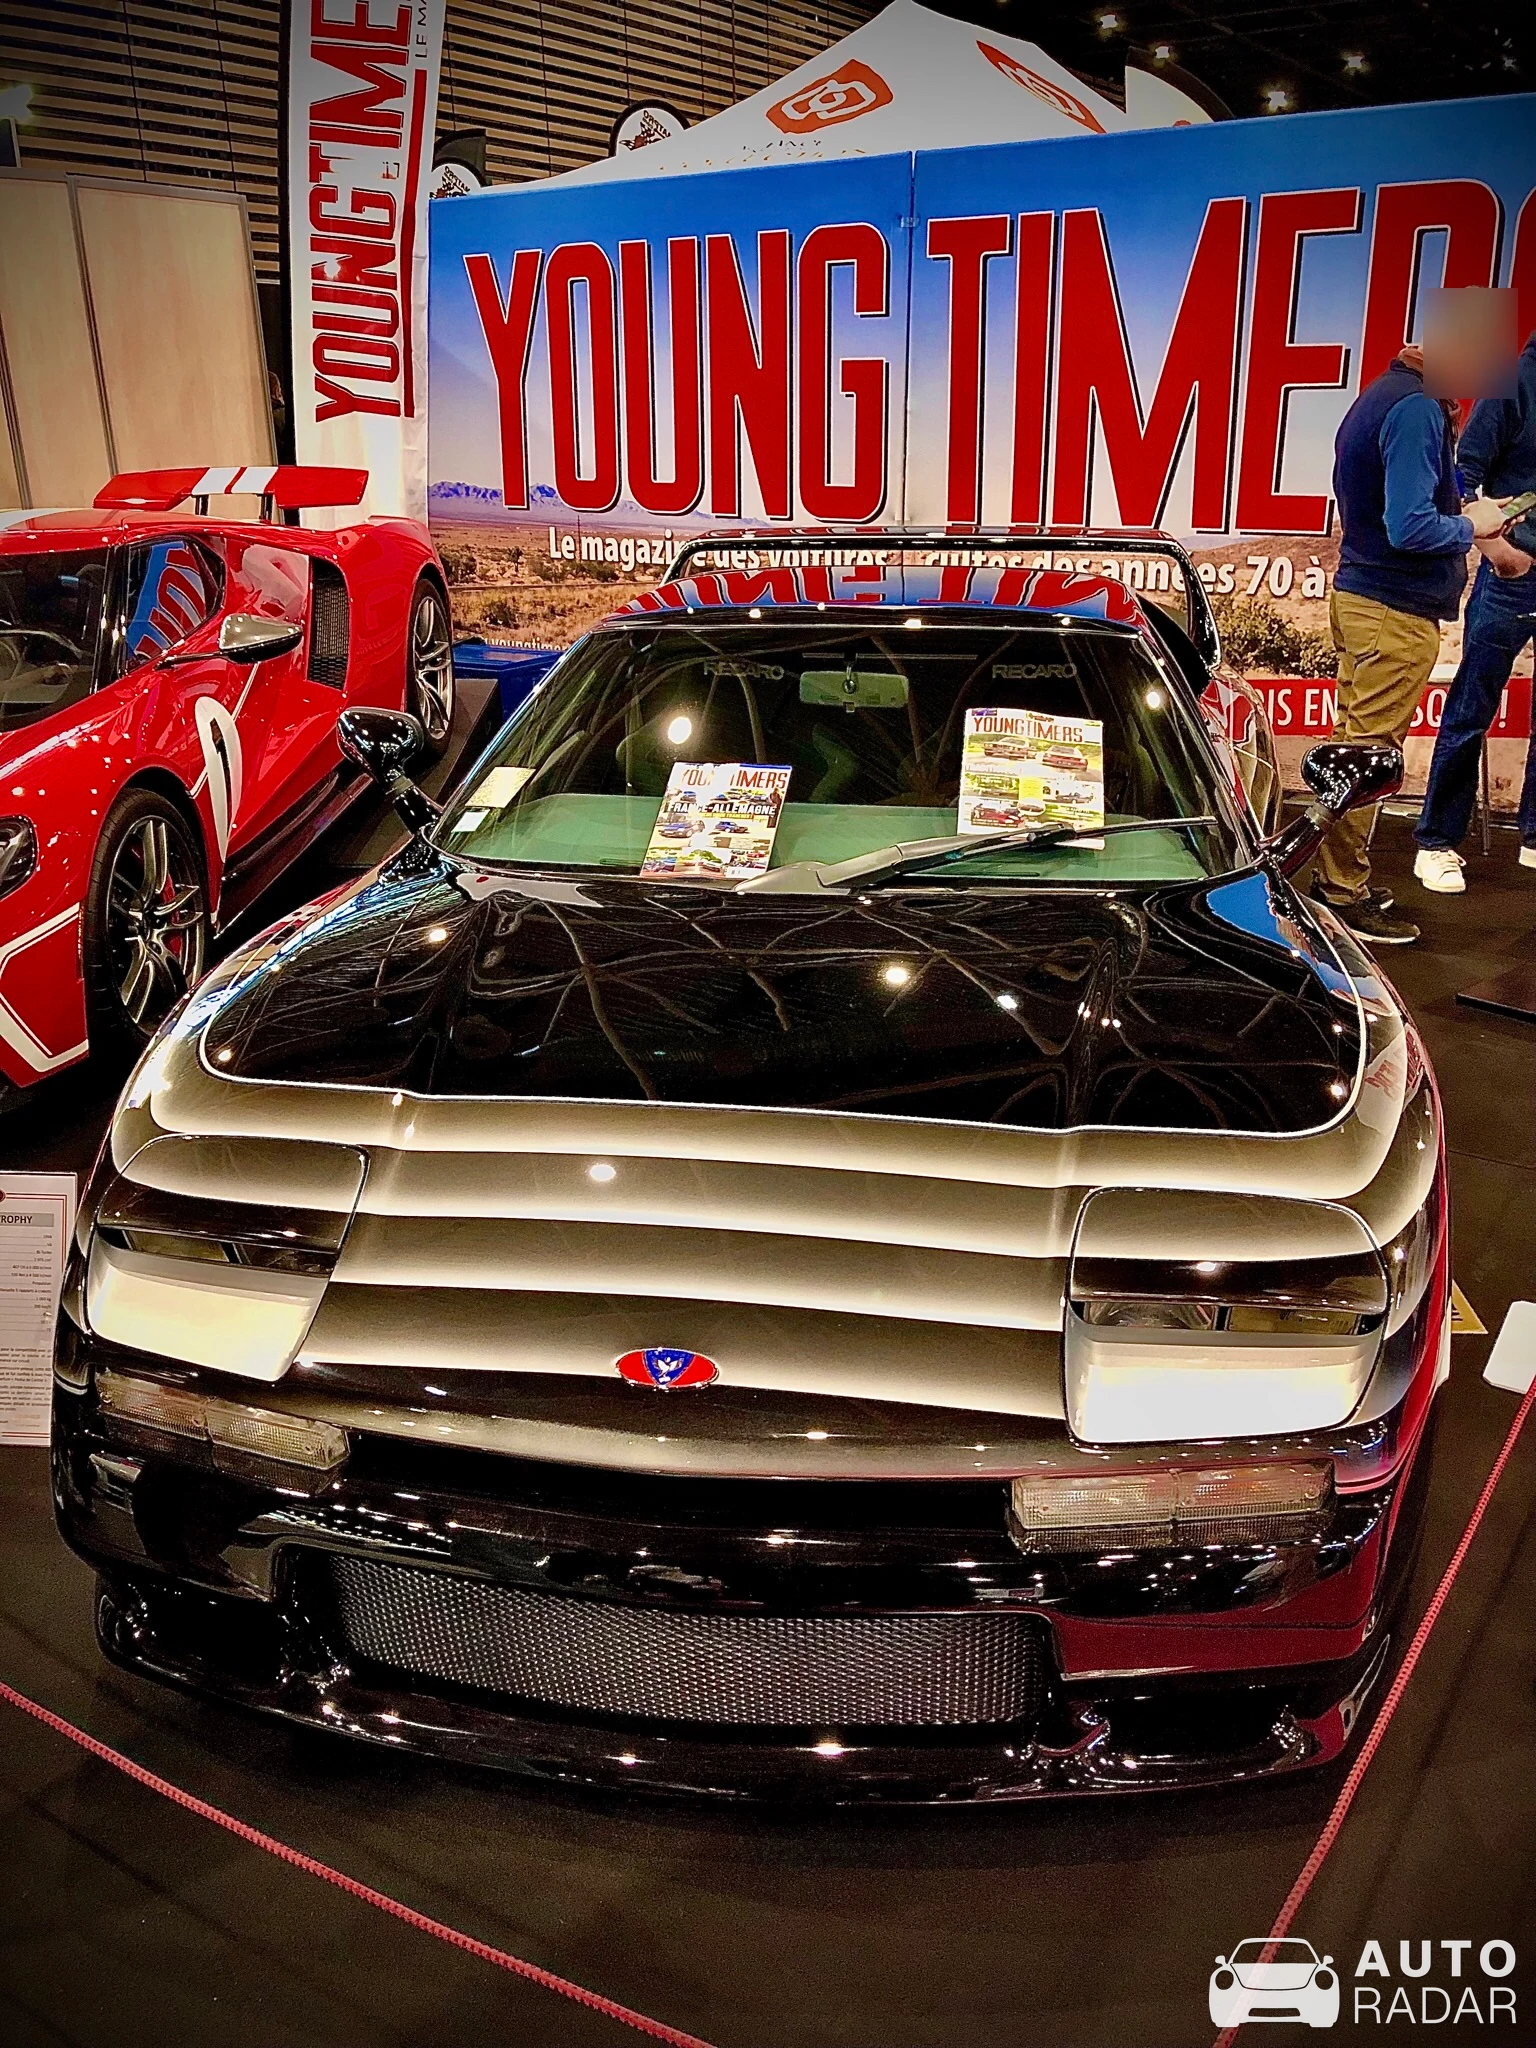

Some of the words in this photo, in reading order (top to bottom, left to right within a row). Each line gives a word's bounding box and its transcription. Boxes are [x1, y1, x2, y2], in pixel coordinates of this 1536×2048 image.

[414, 33, 428, 58] LE
[309, 0, 412, 423] YOUNGTIME
[926, 177, 1536, 537] TIME
[548, 526, 575, 559] Le
[1246, 555, 1294, 597] 70
[1301, 555, 1326, 598] à
[991, 663, 1078, 679] RECARO
[1303, 688, 1339, 726] EN
[973, 717, 1084, 743] YOUNGTIMERS
[667, 802, 776, 815] FRANE-ALLEMAGNE
[0, 1214, 33, 1224] ROPHY
